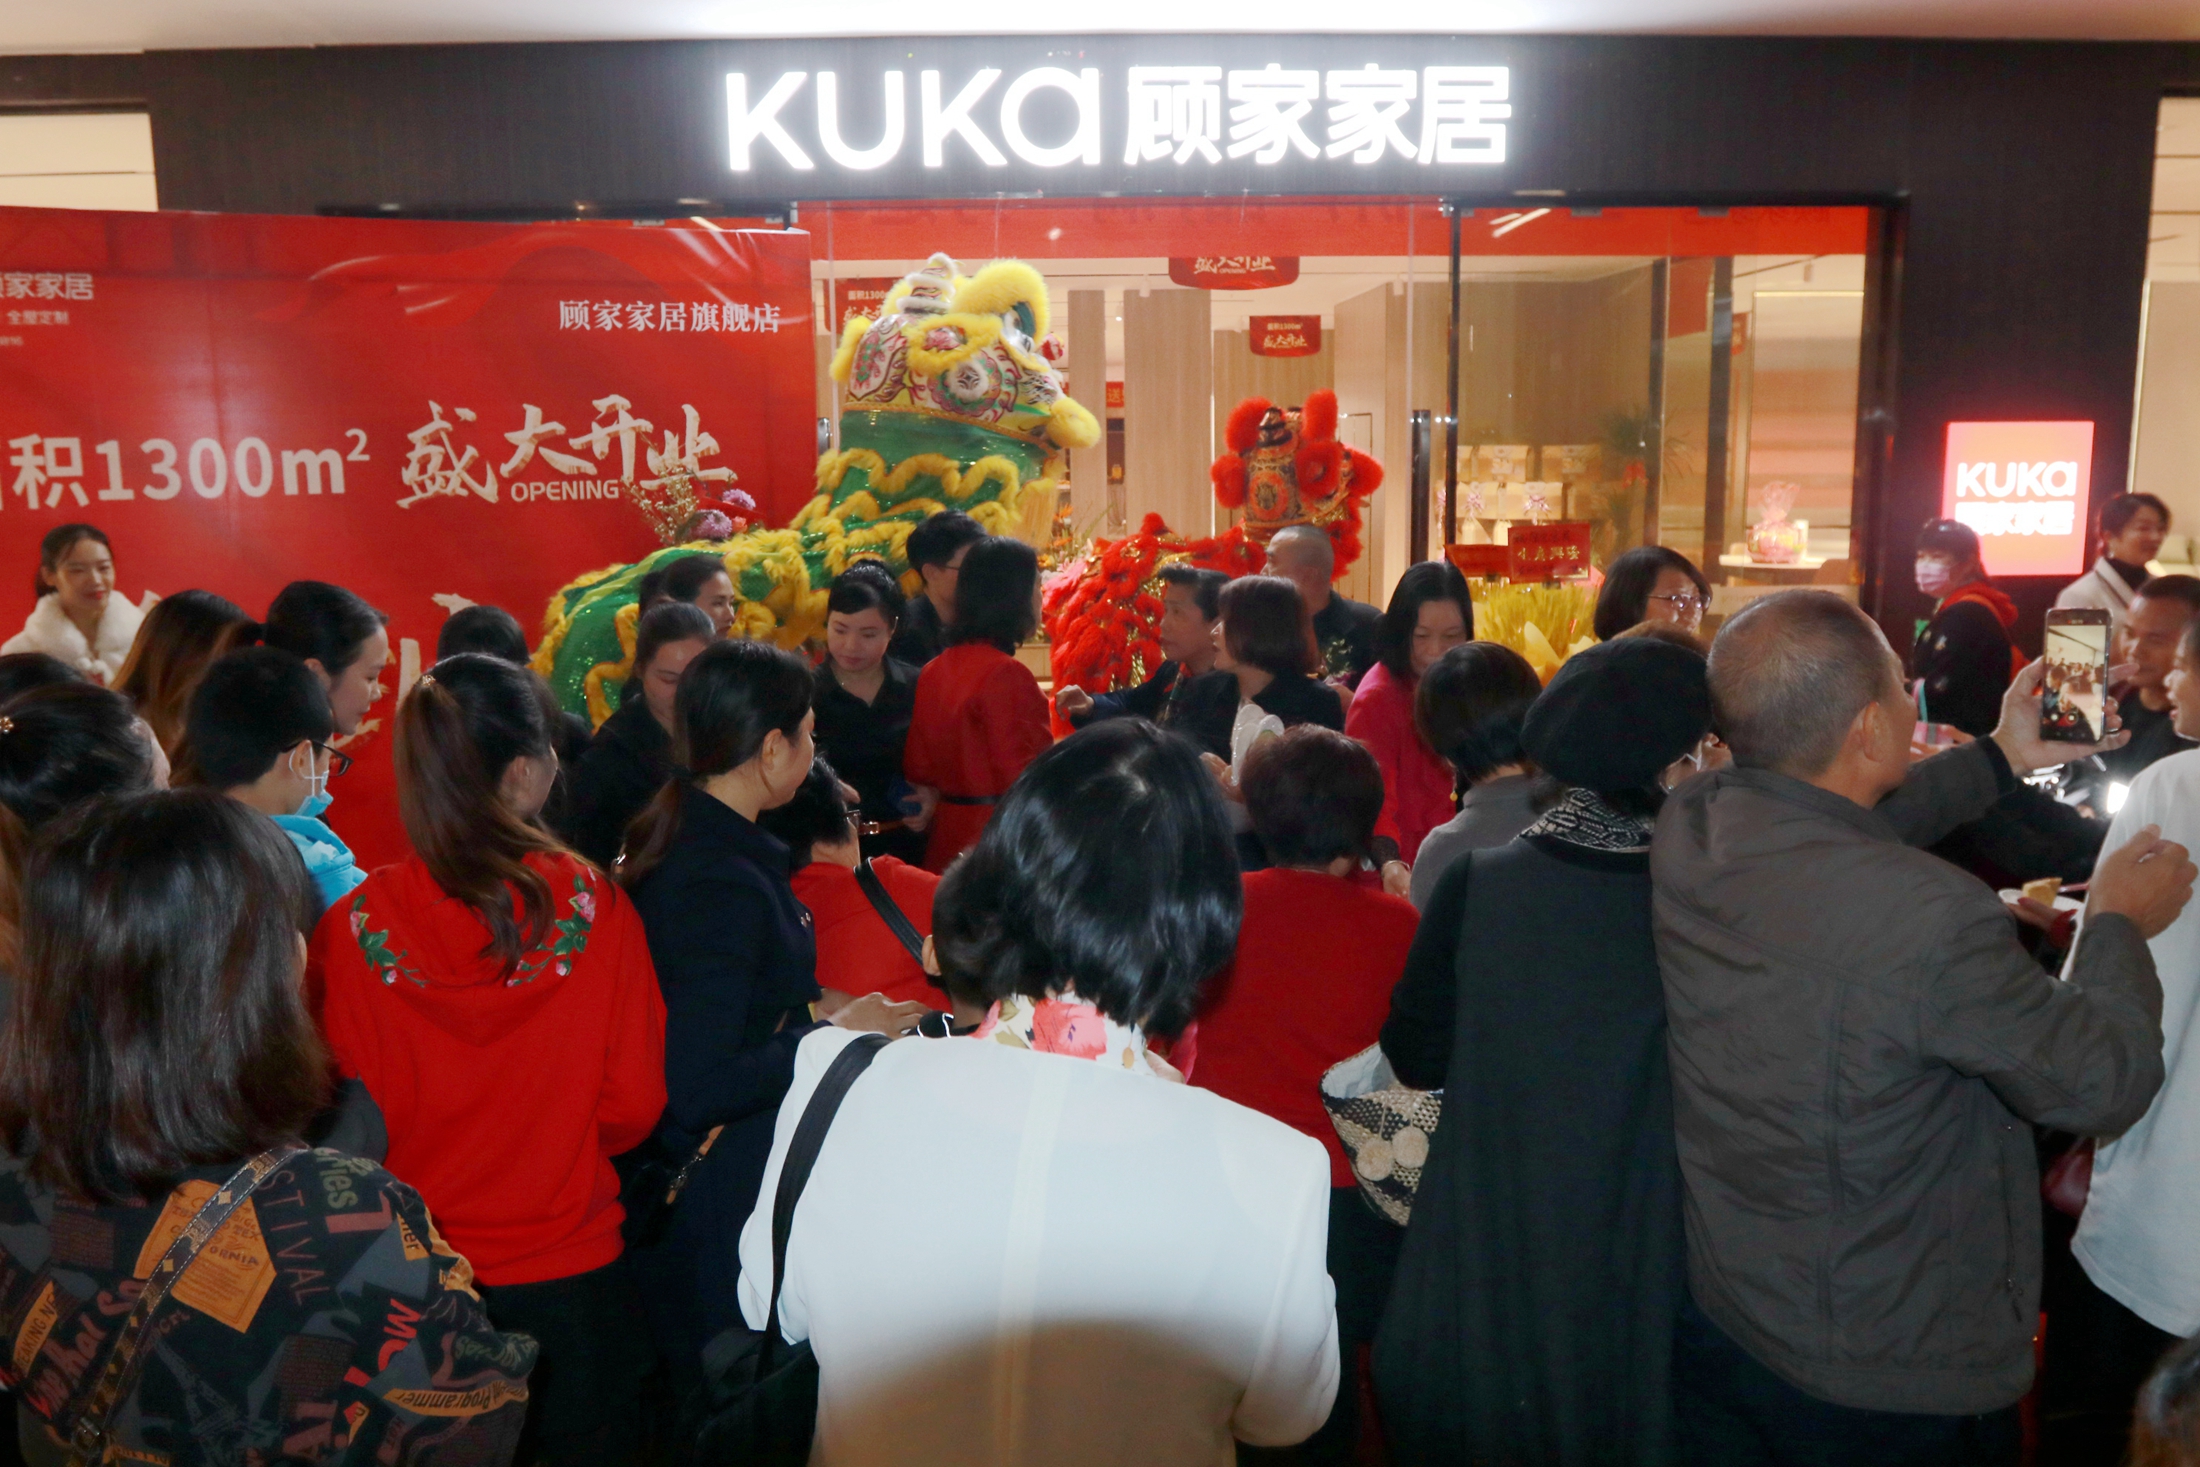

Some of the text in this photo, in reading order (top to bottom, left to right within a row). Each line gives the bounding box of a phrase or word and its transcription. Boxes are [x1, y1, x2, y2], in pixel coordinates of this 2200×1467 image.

[1124, 62, 1513, 166] 顾家家居
[0, 271, 94, 300] 家家居
[559, 298, 781, 334] 顾家家居旗舰店
[0, 428, 370, 510] 积1300m²
[396, 393, 739, 509] 盛大开业
[511, 479, 620, 502] OPENING
